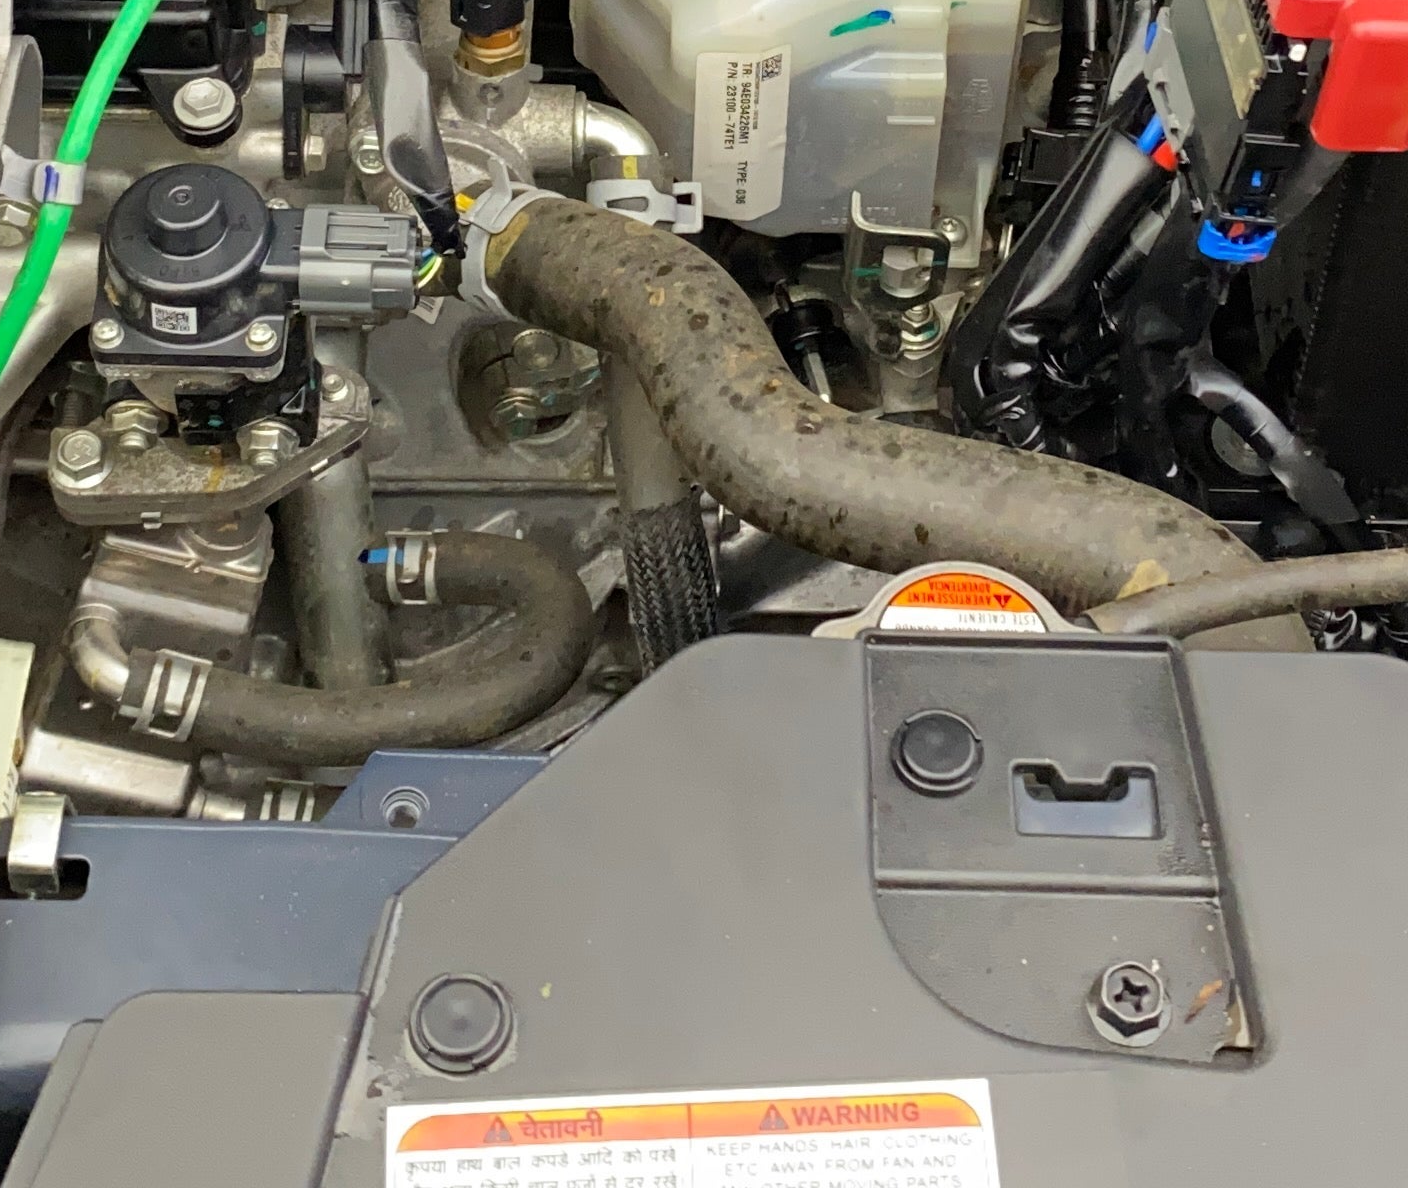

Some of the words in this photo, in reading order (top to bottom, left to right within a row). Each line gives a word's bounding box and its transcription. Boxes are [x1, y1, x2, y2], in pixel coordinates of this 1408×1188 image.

[928, 579, 991, 593] ADVERTENCIA
[907, 591, 992, 606] AVERTISSEMENT
[519, 1109, 603, 1140] चेतावनी
[792, 1102, 921, 1126] WARNING
[706, 1142, 751, 1157] KEEP
[759, 1139, 818, 1154] HANDS
[831, 1136, 871, 1151] HAIR
[883, 1132, 973, 1150] CLOTHING
[825, 1158, 874, 1172] FROM
[883, 1157, 914, 1168] FAN
[923, 1154, 956, 1168] AND
